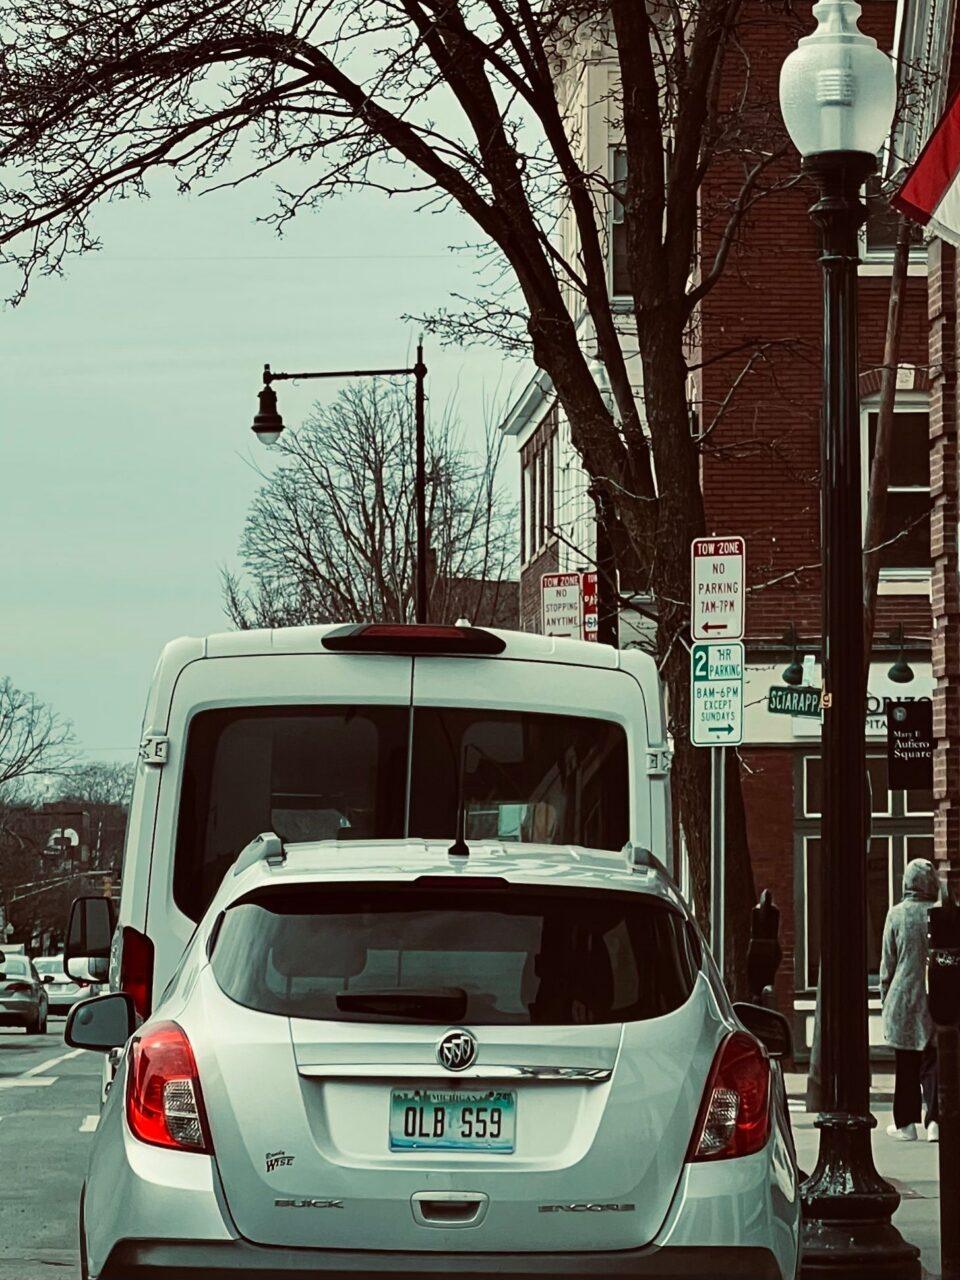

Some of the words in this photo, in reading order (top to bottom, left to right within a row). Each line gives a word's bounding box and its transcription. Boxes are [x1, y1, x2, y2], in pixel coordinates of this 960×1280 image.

[697, 543, 715, 555] TOW
[717, 541, 740, 554] ZONE
[712, 563, 725, 575] NO
[556, 589, 567, 598] NO
[698, 582, 739, 595] PARKING
[545, 602, 578, 613] STOPPING
[701, 600, 735, 614] 7AM-7PM
[546, 616, 578, 627] ANYTIME
[694, 650, 707, 677] 2
[718, 649, 732, 661] HR
[709, 665, 741, 677] PARKING
[696, 687, 739, 699] 8AM-6PM
[704, 700, 732, 710] EXCEPT
[701, 711, 736, 722] SUNDAYS
[894, 749, 932, 761] Square
[274, 1199, 345, 1209] BUICK
[538, 1204, 636, 1213] ENCORE
